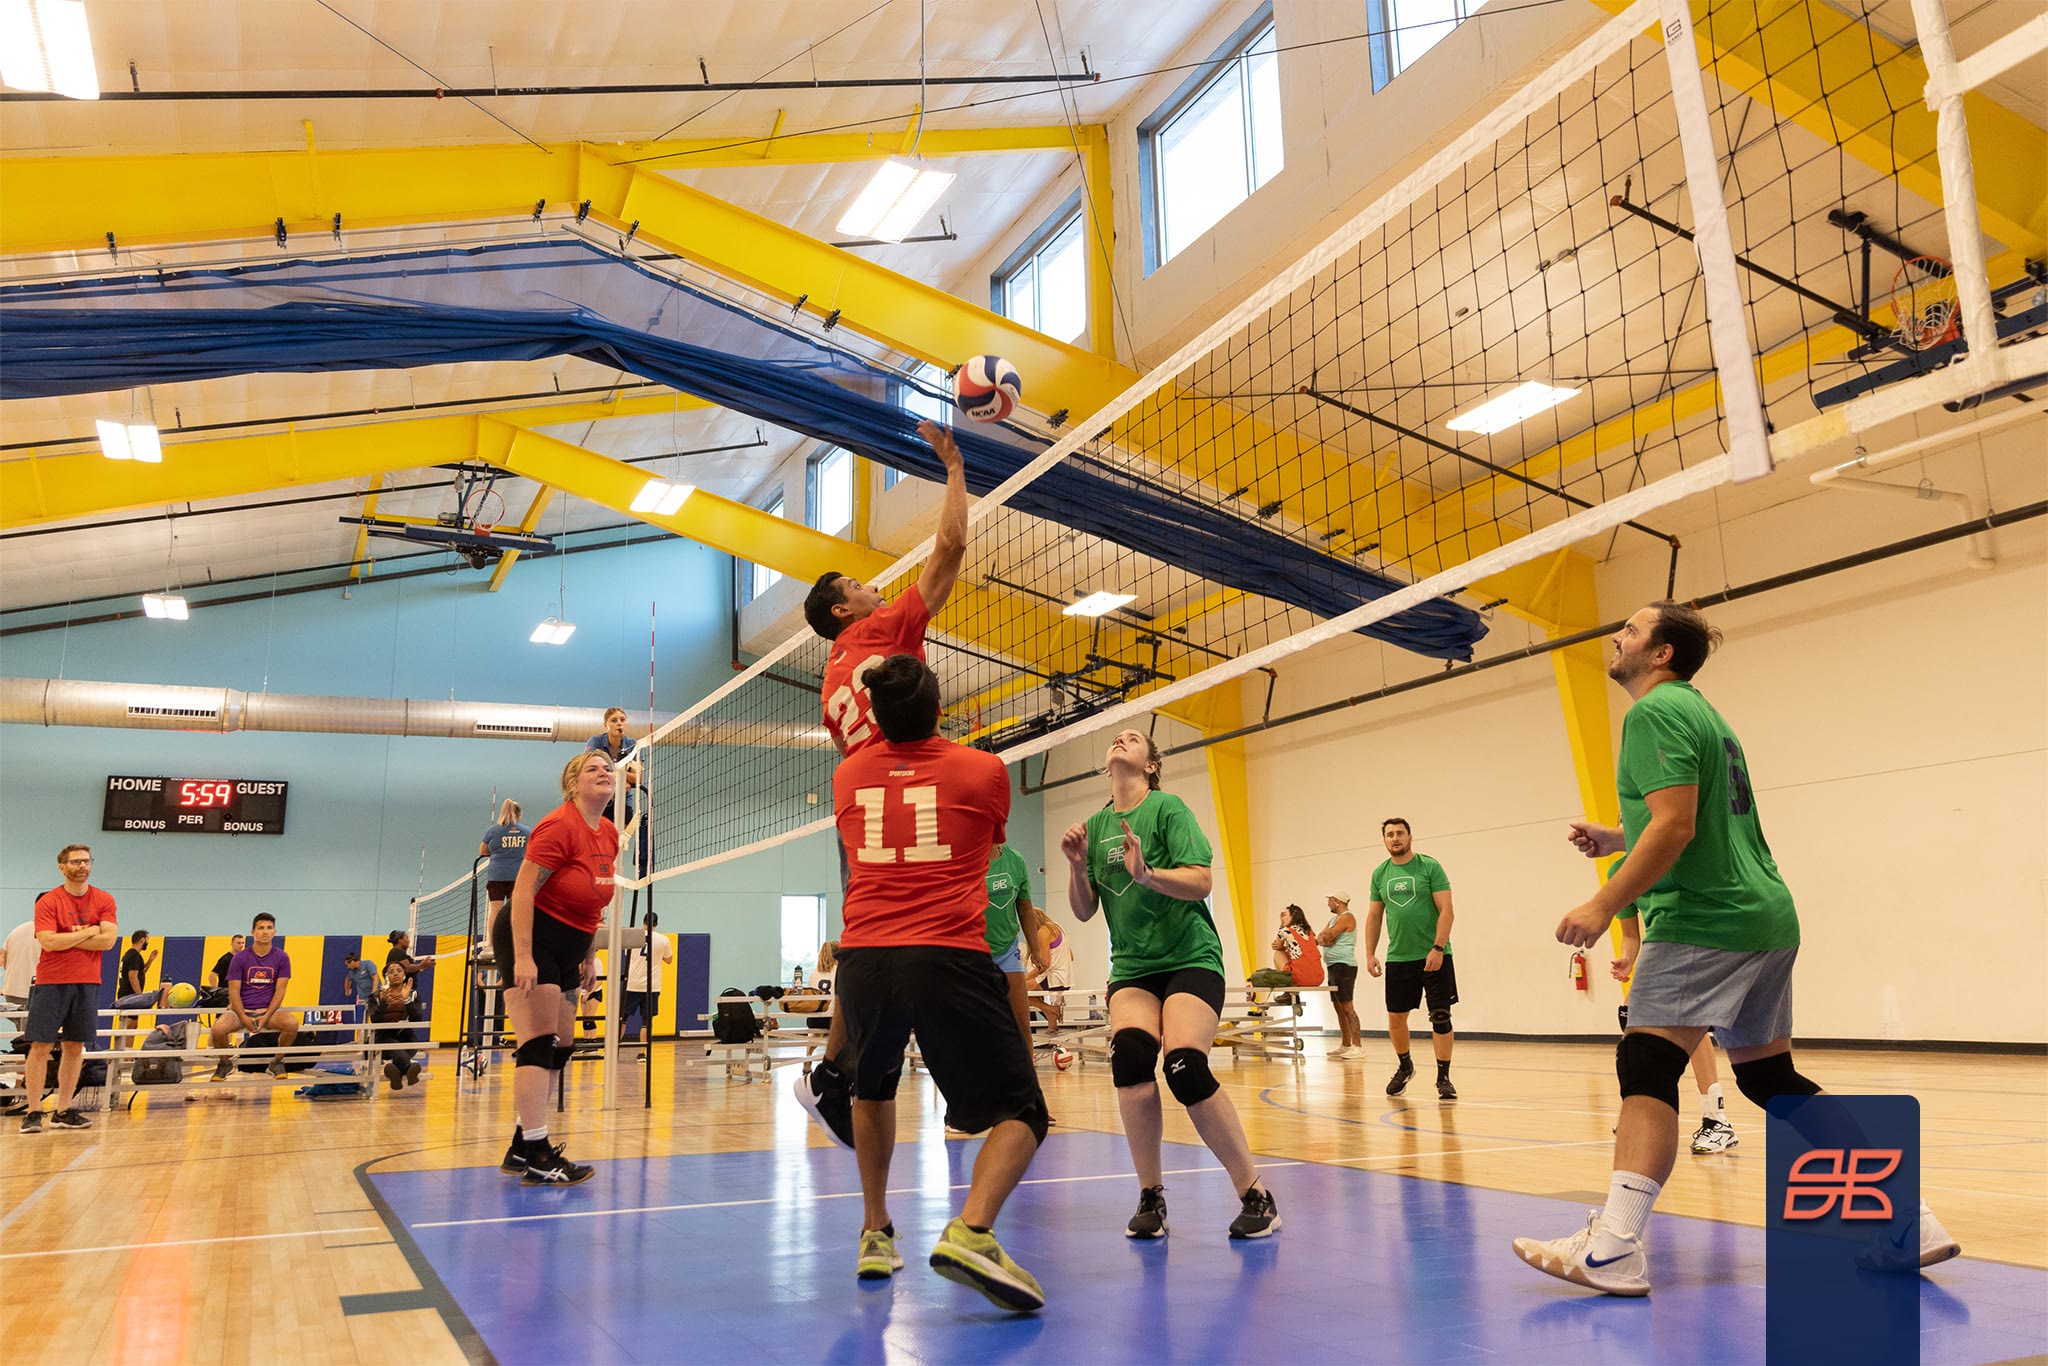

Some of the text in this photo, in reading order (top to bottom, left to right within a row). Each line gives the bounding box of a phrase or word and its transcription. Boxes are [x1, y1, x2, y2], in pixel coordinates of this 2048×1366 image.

[110, 778, 162, 791] HOME
[236, 782, 285, 795] GUEST
[180, 782, 232, 806] 5:59
[124, 819, 166, 829] BONUS
[178, 814, 204, 824] PER
[855, 785, 953, 863] 11
[223, 822, 264, 832] BONUS
[502, 836, 526, 848] STAFF
